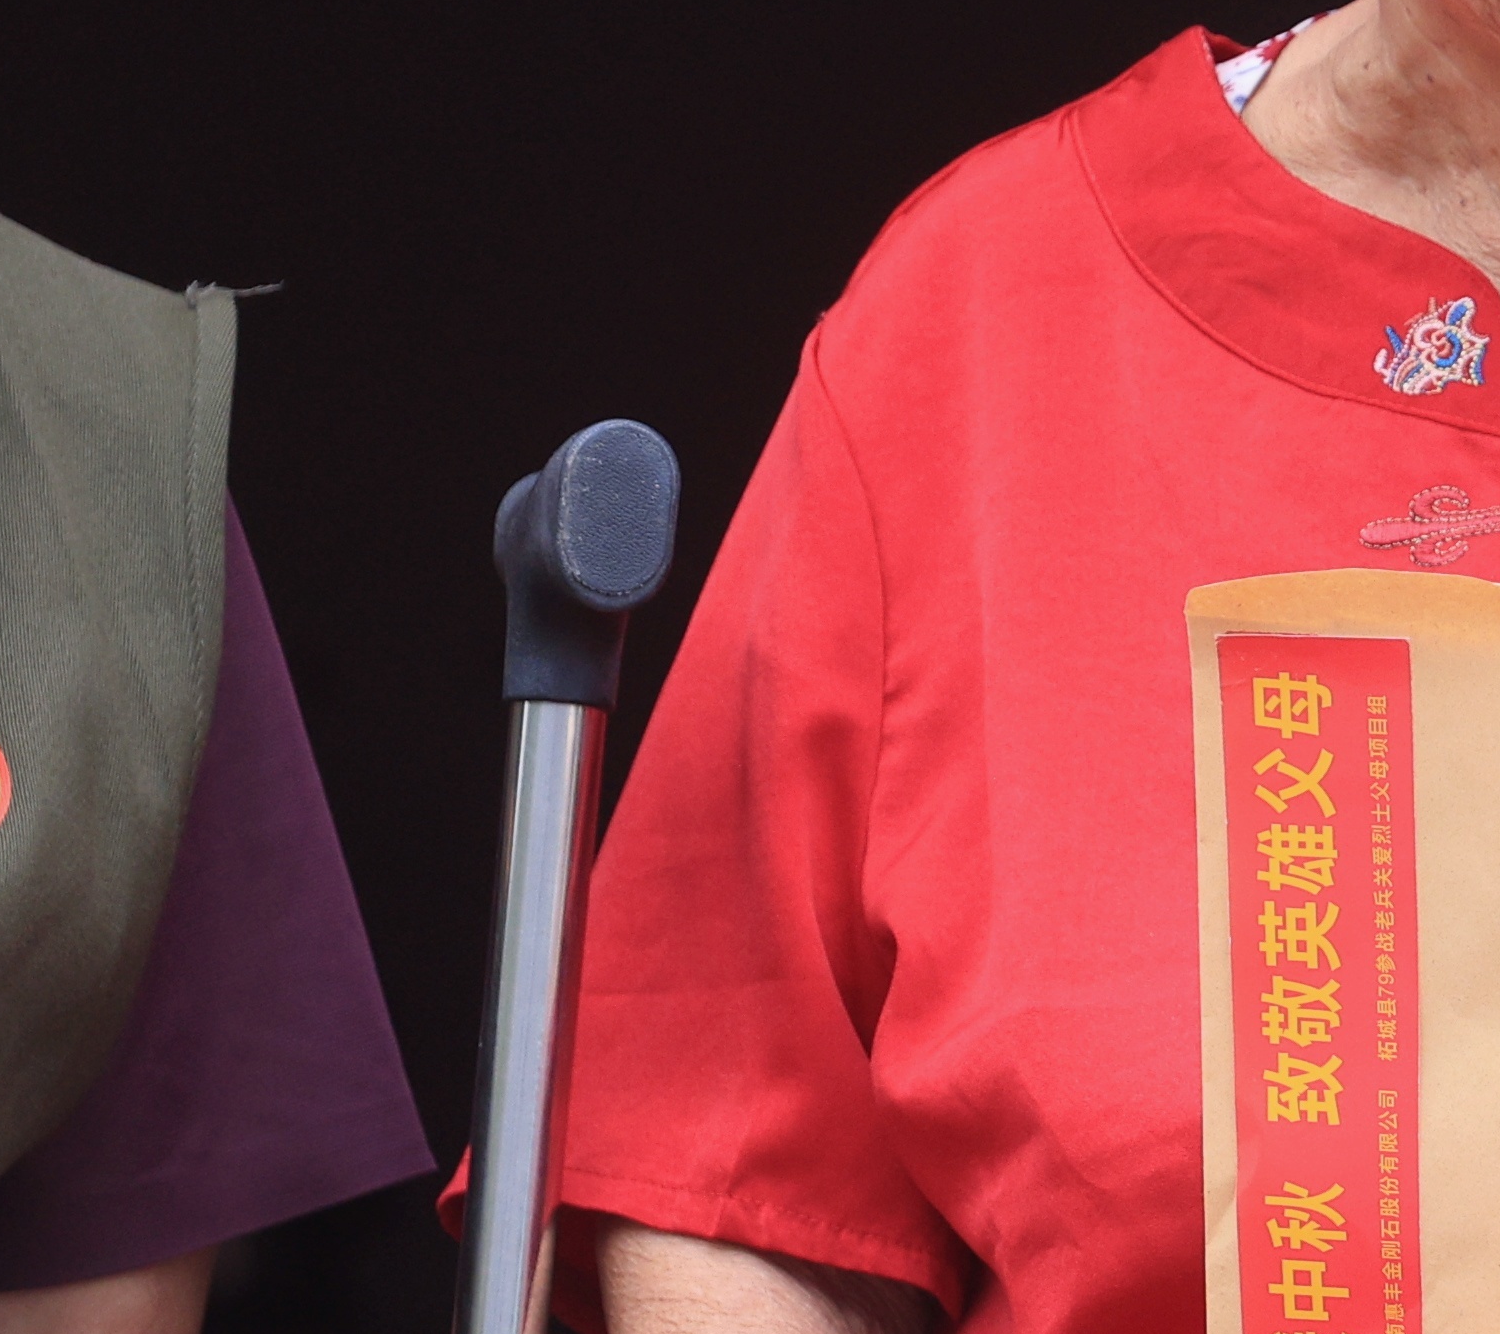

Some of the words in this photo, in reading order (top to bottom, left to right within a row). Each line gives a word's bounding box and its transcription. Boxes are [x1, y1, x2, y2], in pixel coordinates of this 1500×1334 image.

[1251, 670, 1345, 1127] 致敬英雄父母
[1366, 694, 1399, 1062] 柘城县79参战老兵关爱烈士父母项目组
